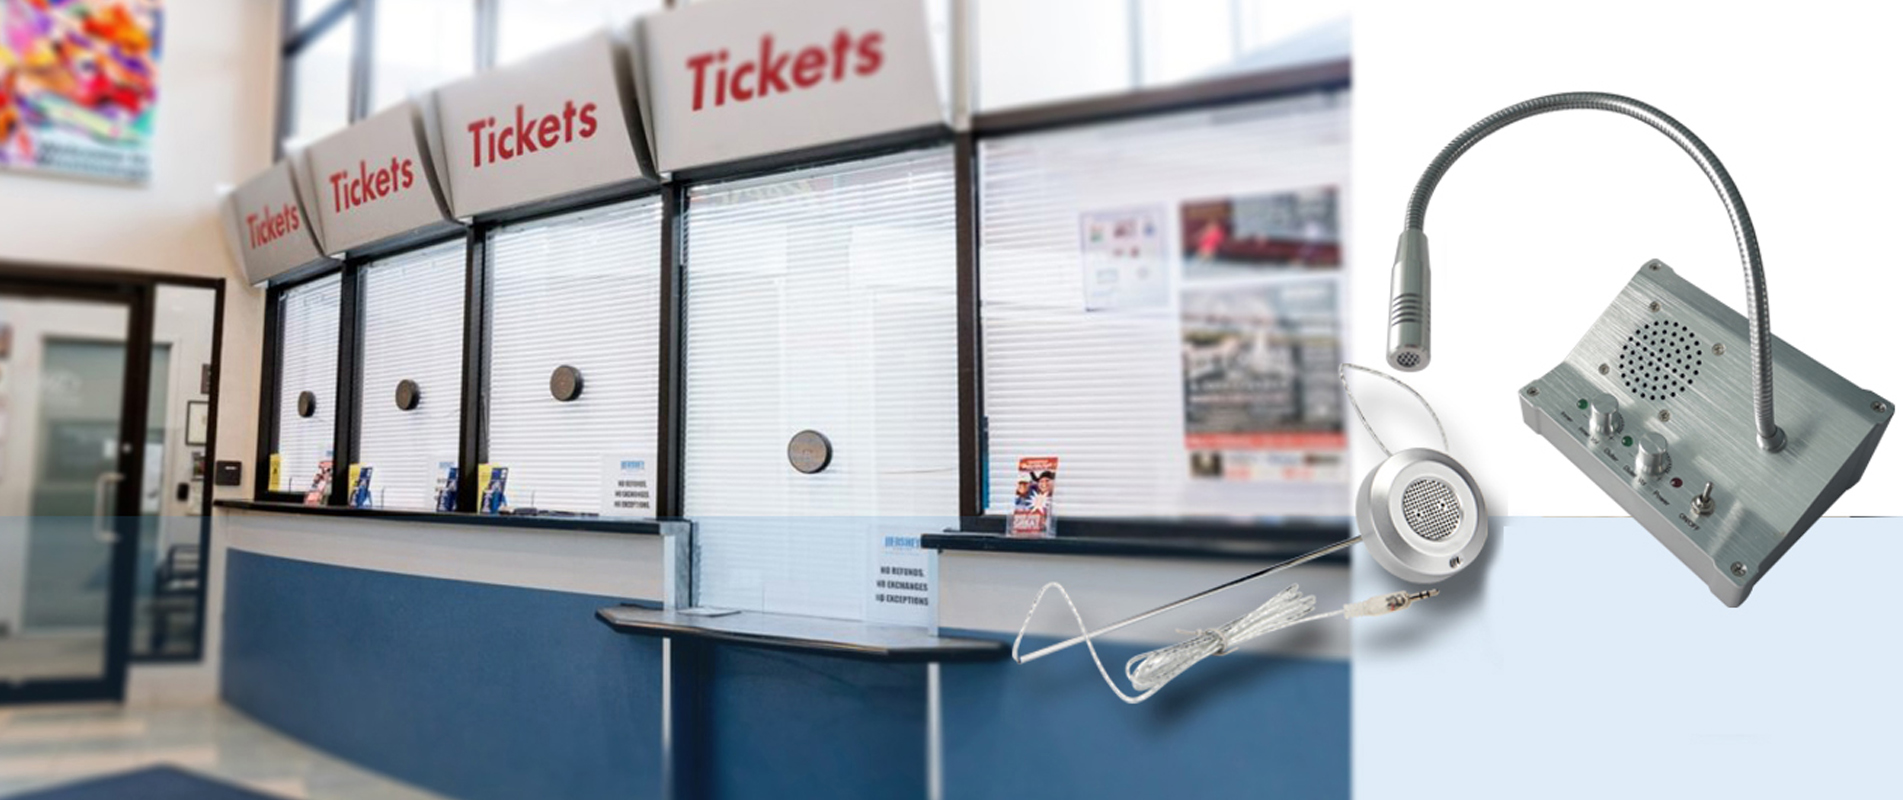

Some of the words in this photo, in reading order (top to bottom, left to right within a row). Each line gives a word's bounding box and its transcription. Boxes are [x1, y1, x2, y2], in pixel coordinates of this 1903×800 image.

[685, 28, 885, 112] Tickets
[467, 99, 598, 167] Tickets
[329, 156, 414, 213] Tickets
[246, 202, 300, 250] Tickets
[1653, 490, 1669, 506] Power
[1679, 513, 1700, 531] ON/OFF
[880, 566, 890, 575] NO
